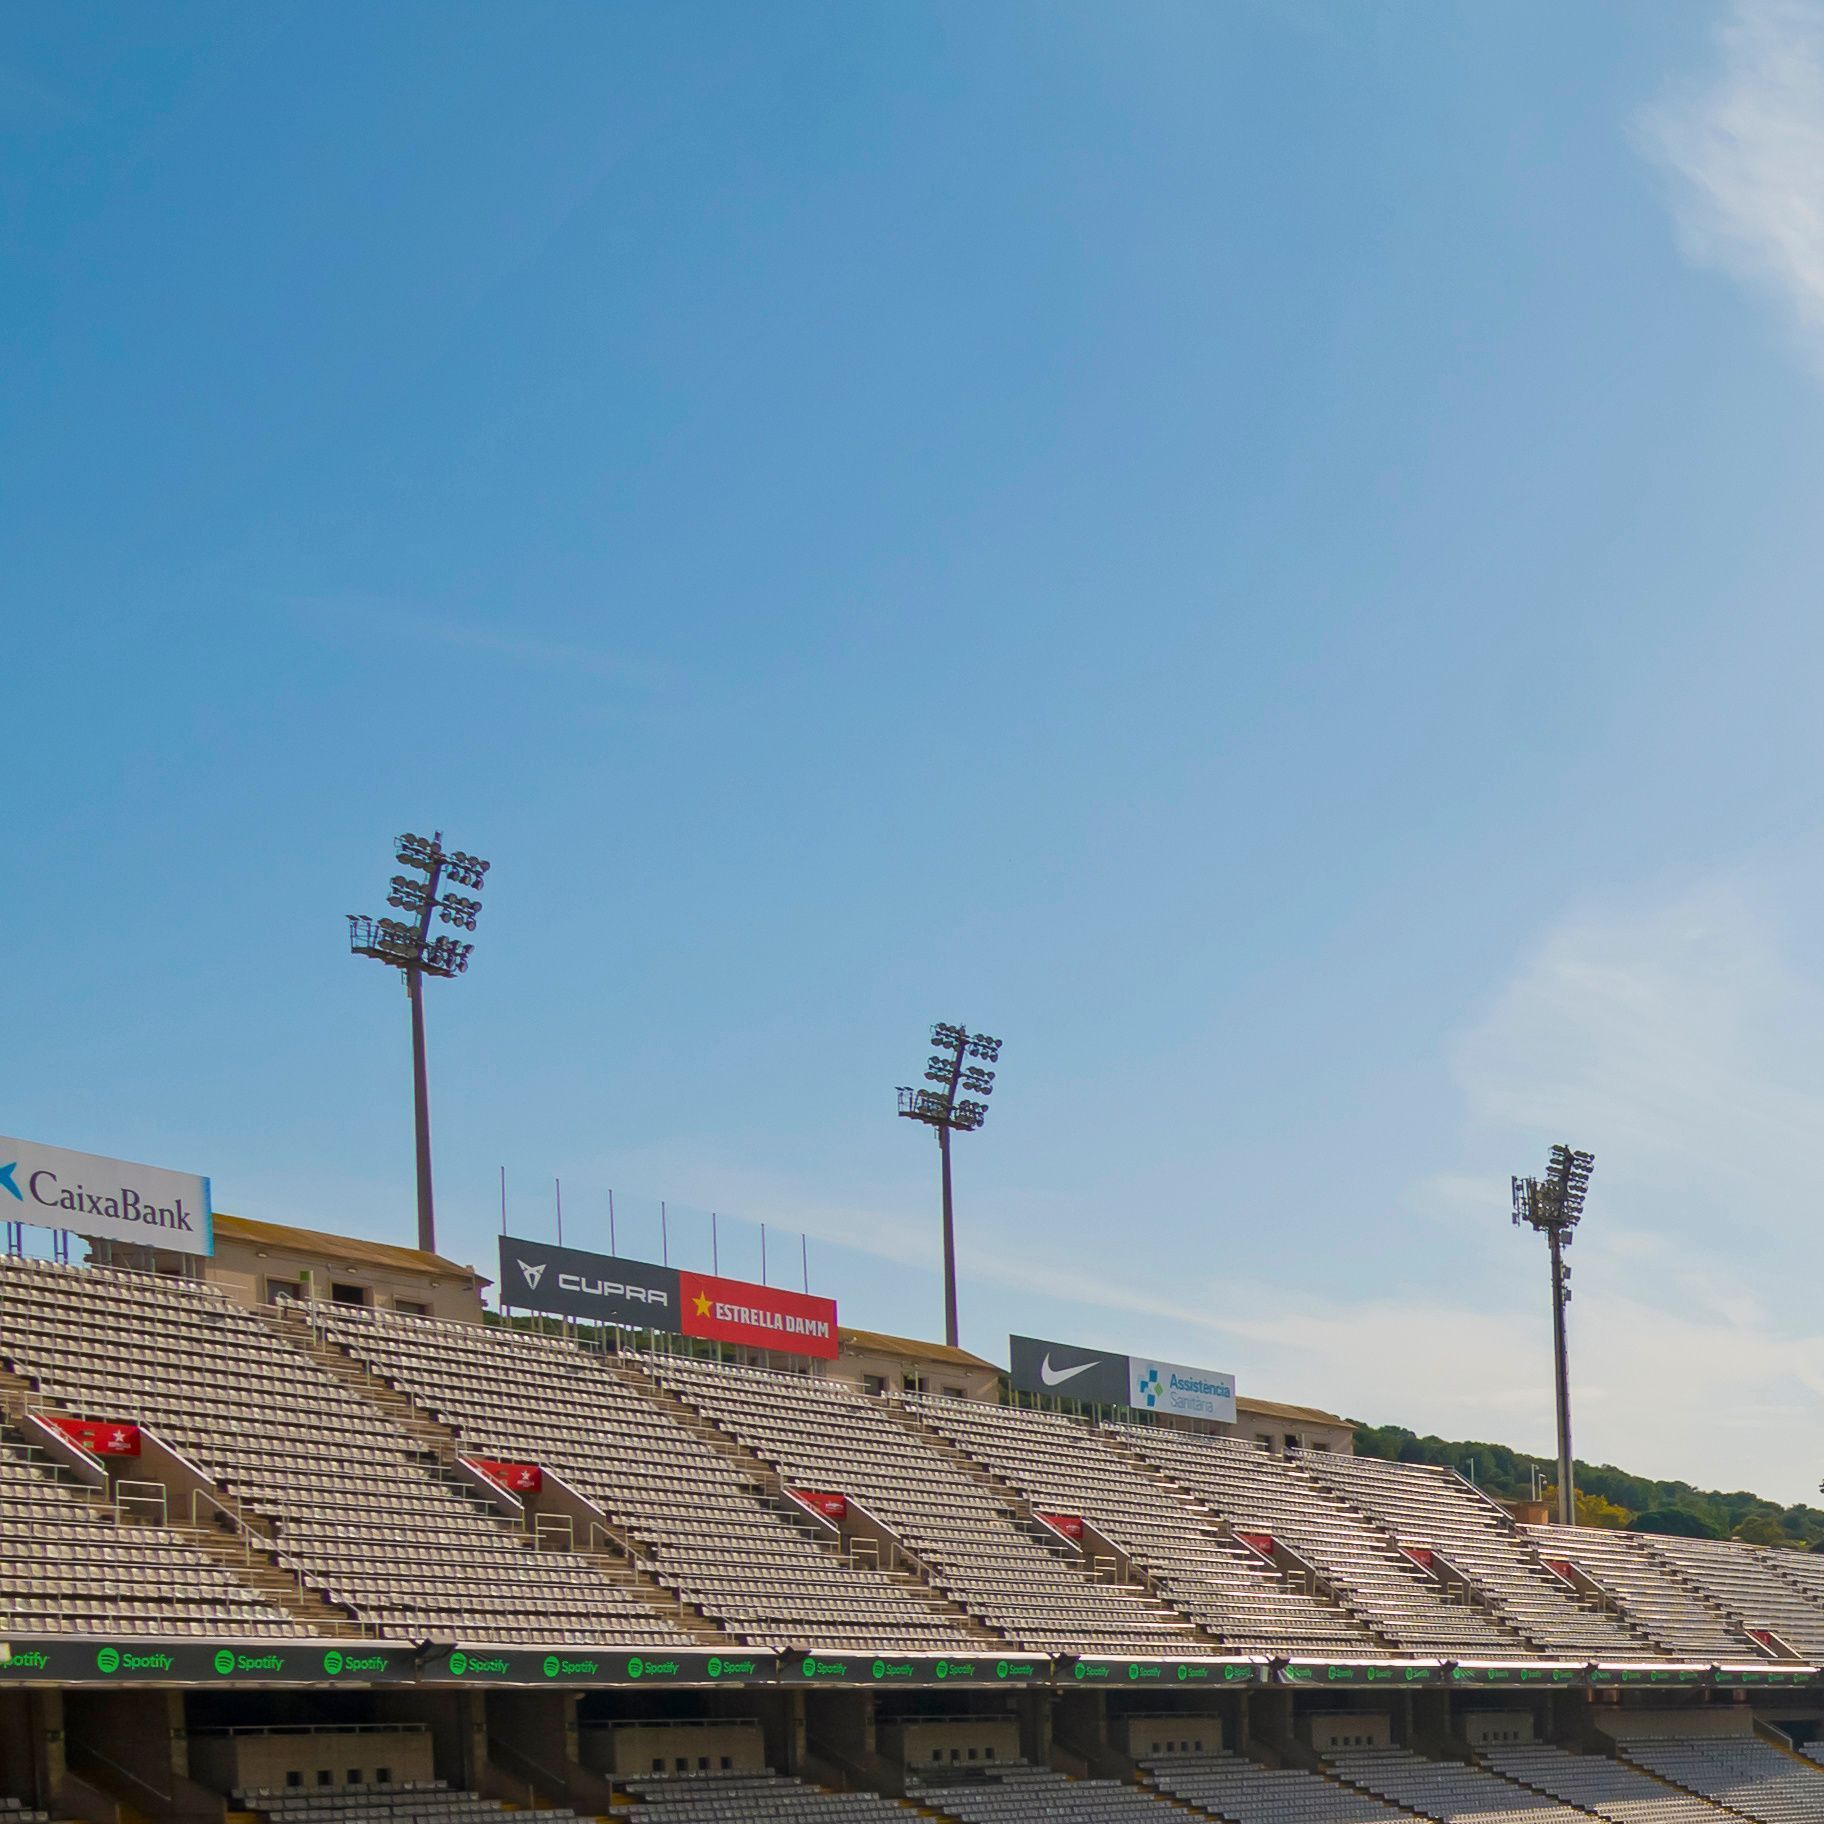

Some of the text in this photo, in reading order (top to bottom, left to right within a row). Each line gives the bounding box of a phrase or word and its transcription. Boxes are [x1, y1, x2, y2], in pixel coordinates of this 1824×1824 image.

[30, 1170, 194, 1232] CaixaBank
[558, 1273, 668, 1307] CUPRA
[715, 1303, 830, 1339] ESTRELLA DAMM
[1169, 1373, 1231, 1398] Assistència
[1, 1650, 48, 1671] potify
[122, 1653, 174, 1672] Spotify
[237, 1655, 285, 1672] Spotify
[345, 1655, 389, 1673] Spotify
[468, 1657, 509, 1675] Spotify
[561, 1659, 599, 1676] Spotify
[644, 1661, 679, 1677] Spotify
[722, 1661, 757, 1676] Spotify
[816, 1662, 848, 1677] Spotify
